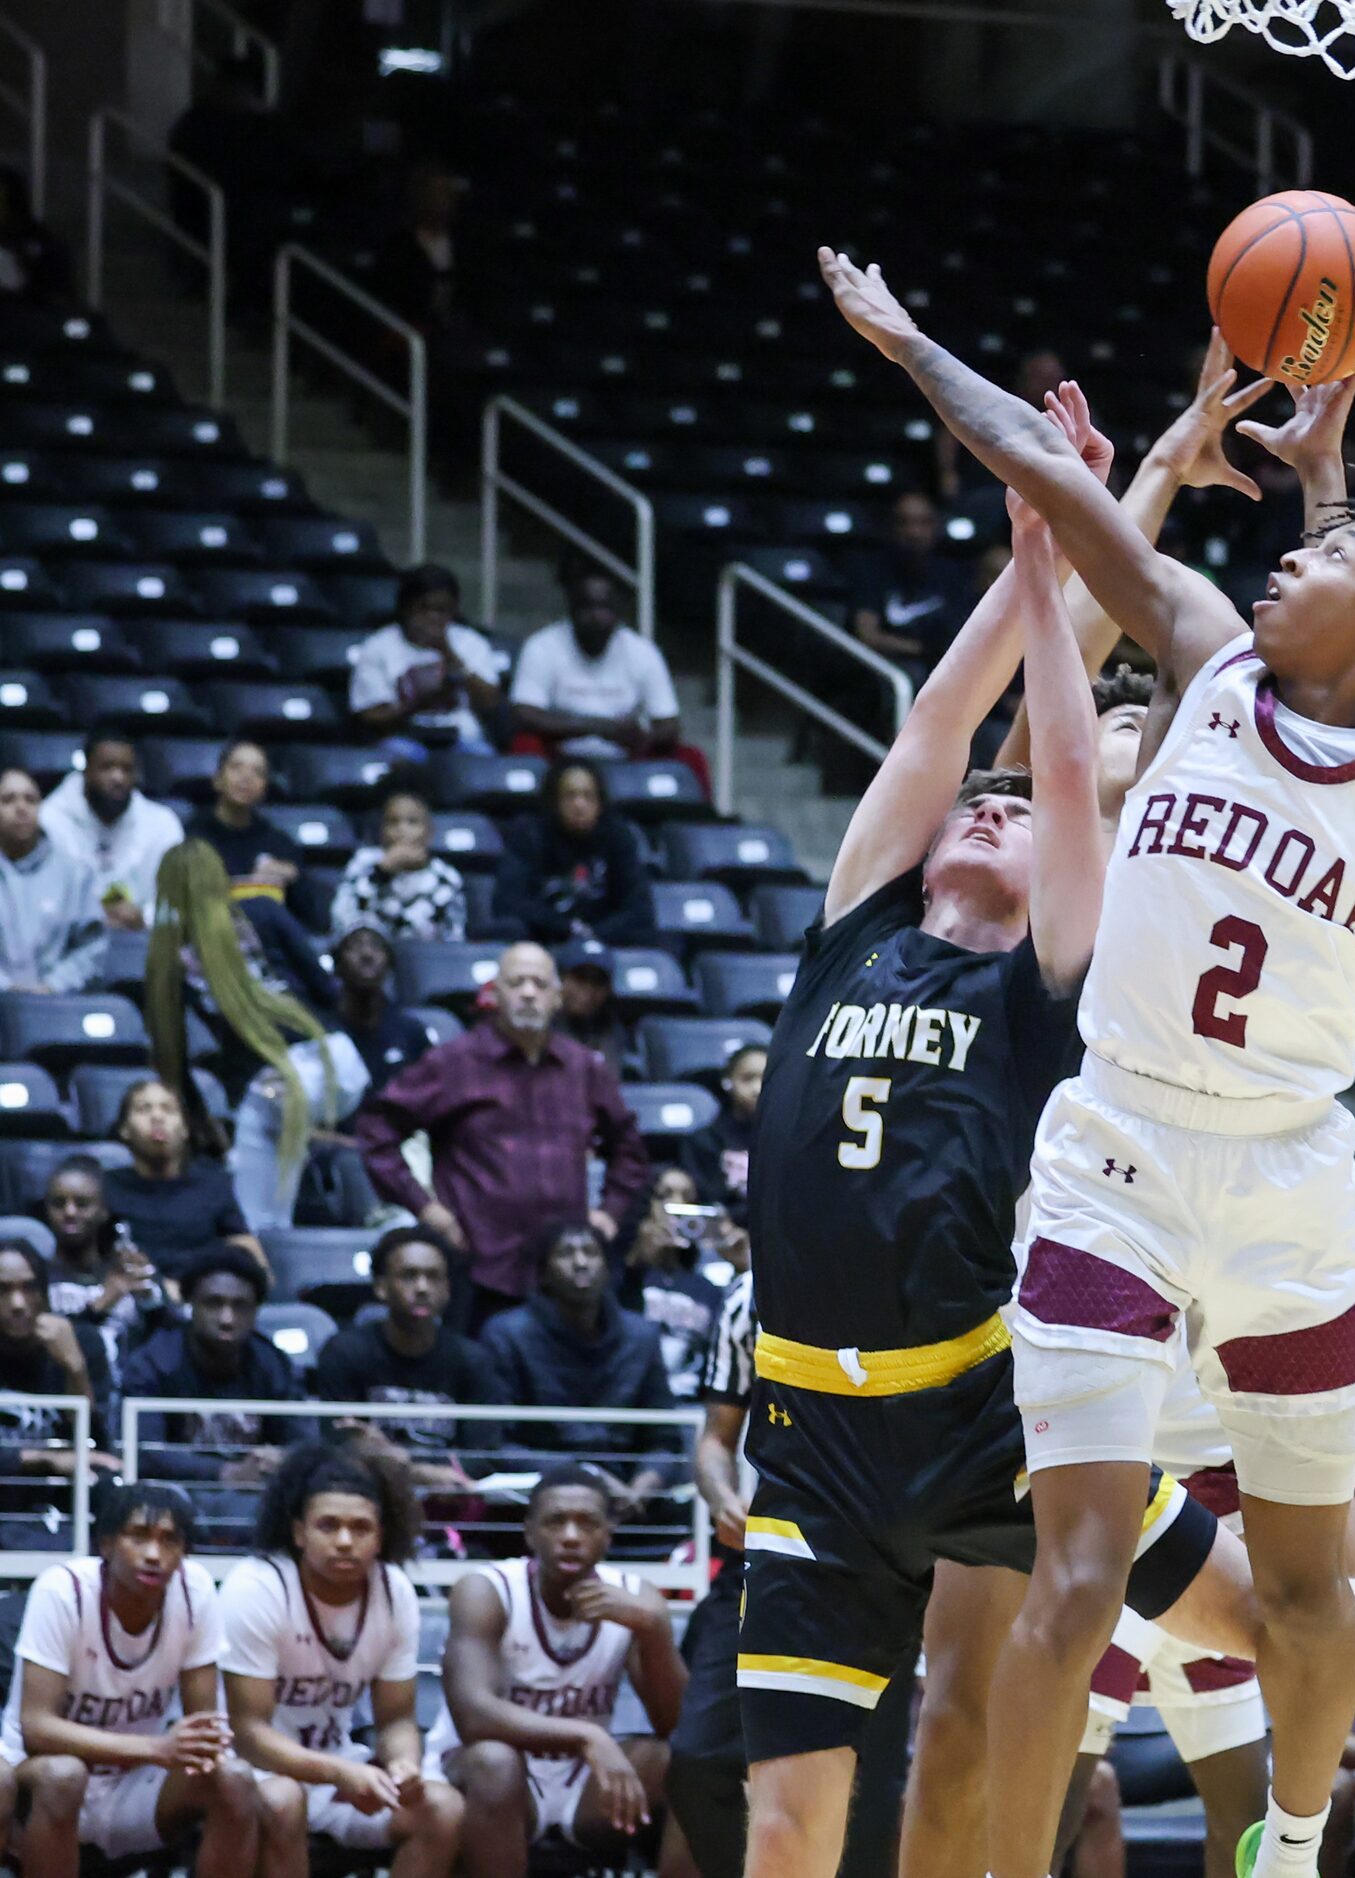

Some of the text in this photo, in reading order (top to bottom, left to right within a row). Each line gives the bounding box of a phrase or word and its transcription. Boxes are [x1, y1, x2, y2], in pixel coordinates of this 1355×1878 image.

[1280, 276, 1339, 382] Baden
[1128, 793, 1269, 872] RED
[1192, 914, 1269, 1049] 2
[806, 1001, 982, 1072] FORNEY
[838, 1076, 892, 1170] 5
